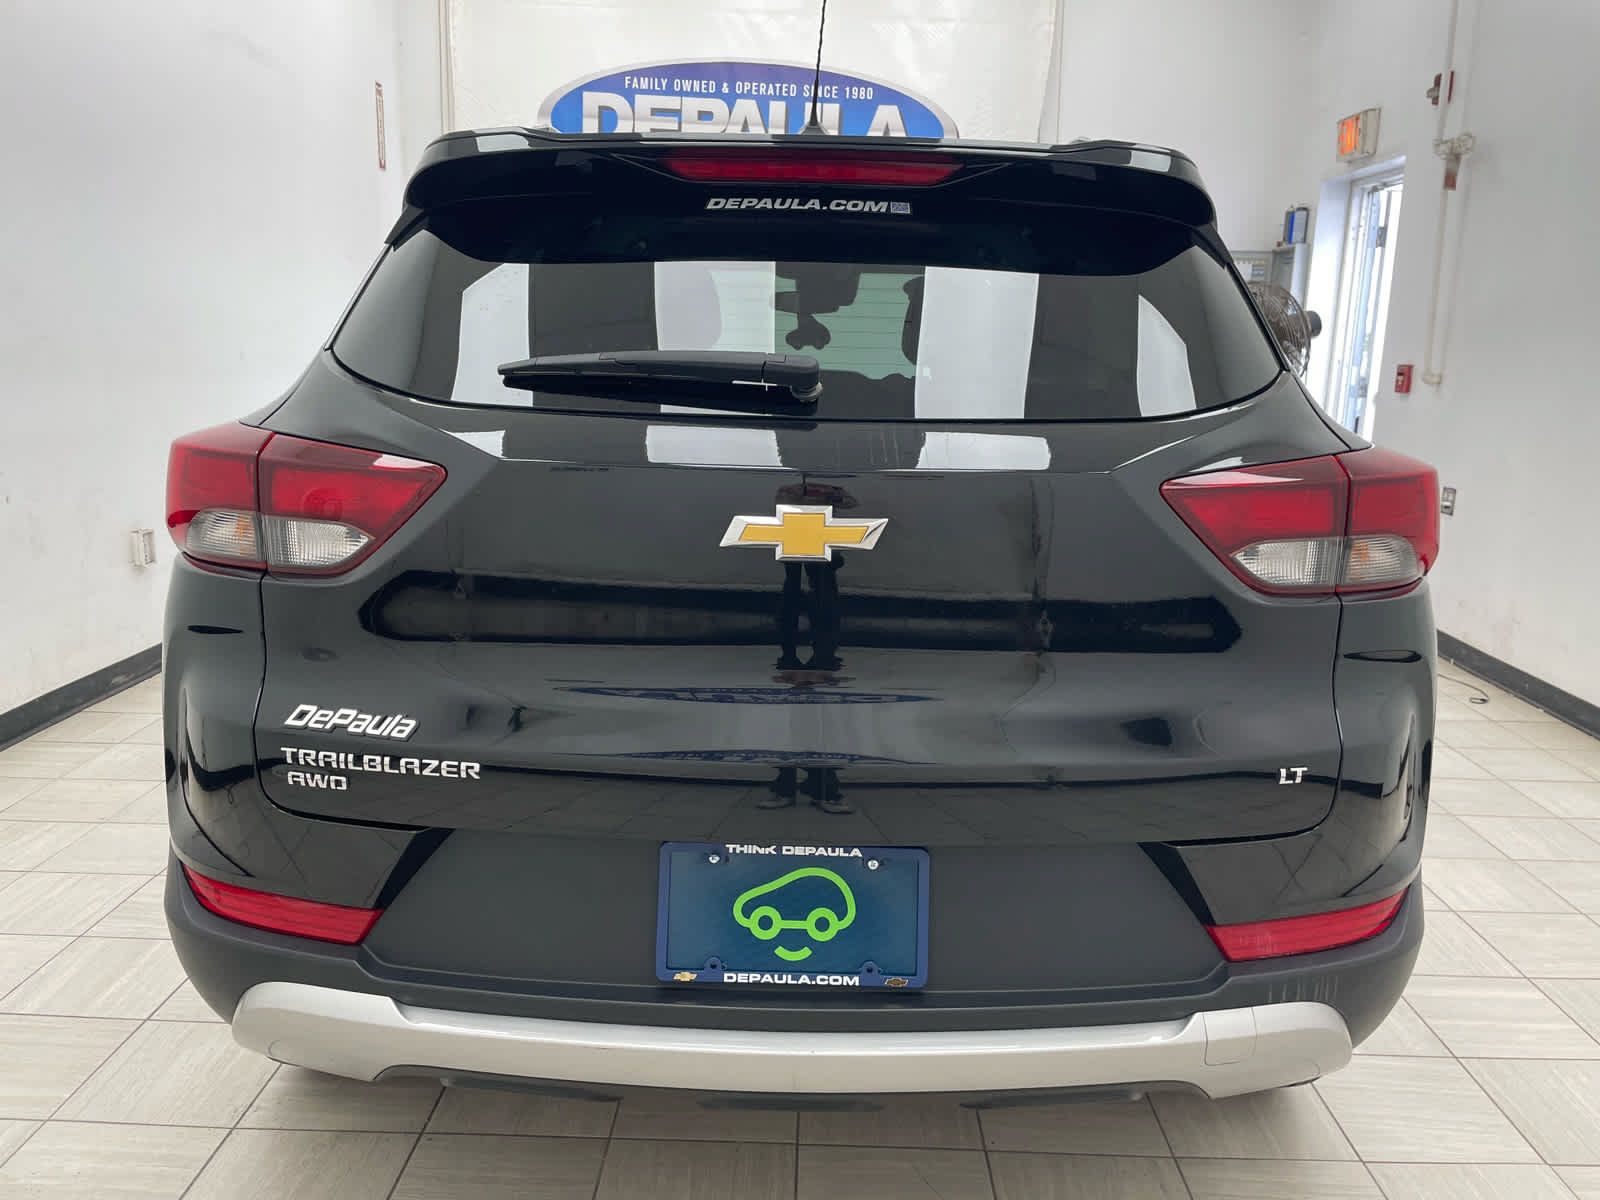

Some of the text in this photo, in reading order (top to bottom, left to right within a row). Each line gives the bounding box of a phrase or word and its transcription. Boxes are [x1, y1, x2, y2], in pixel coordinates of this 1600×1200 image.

[624, 76, 874, 100] FAMILY OWNED & OPERATED SINCE 1980
[706, 198, 889, 213] DEPAULA.COM
[284, 704, 418, 739] DePaula
[280, 747, 481, 780] TRAILBLAZER
[287, 771, 348, 791] AWD
[1279, 767, 1309, 785] LT
[725, 844, 863, 857] THINK DEPAULA
[723, 972, 860, 986] DEPAULA.COM
